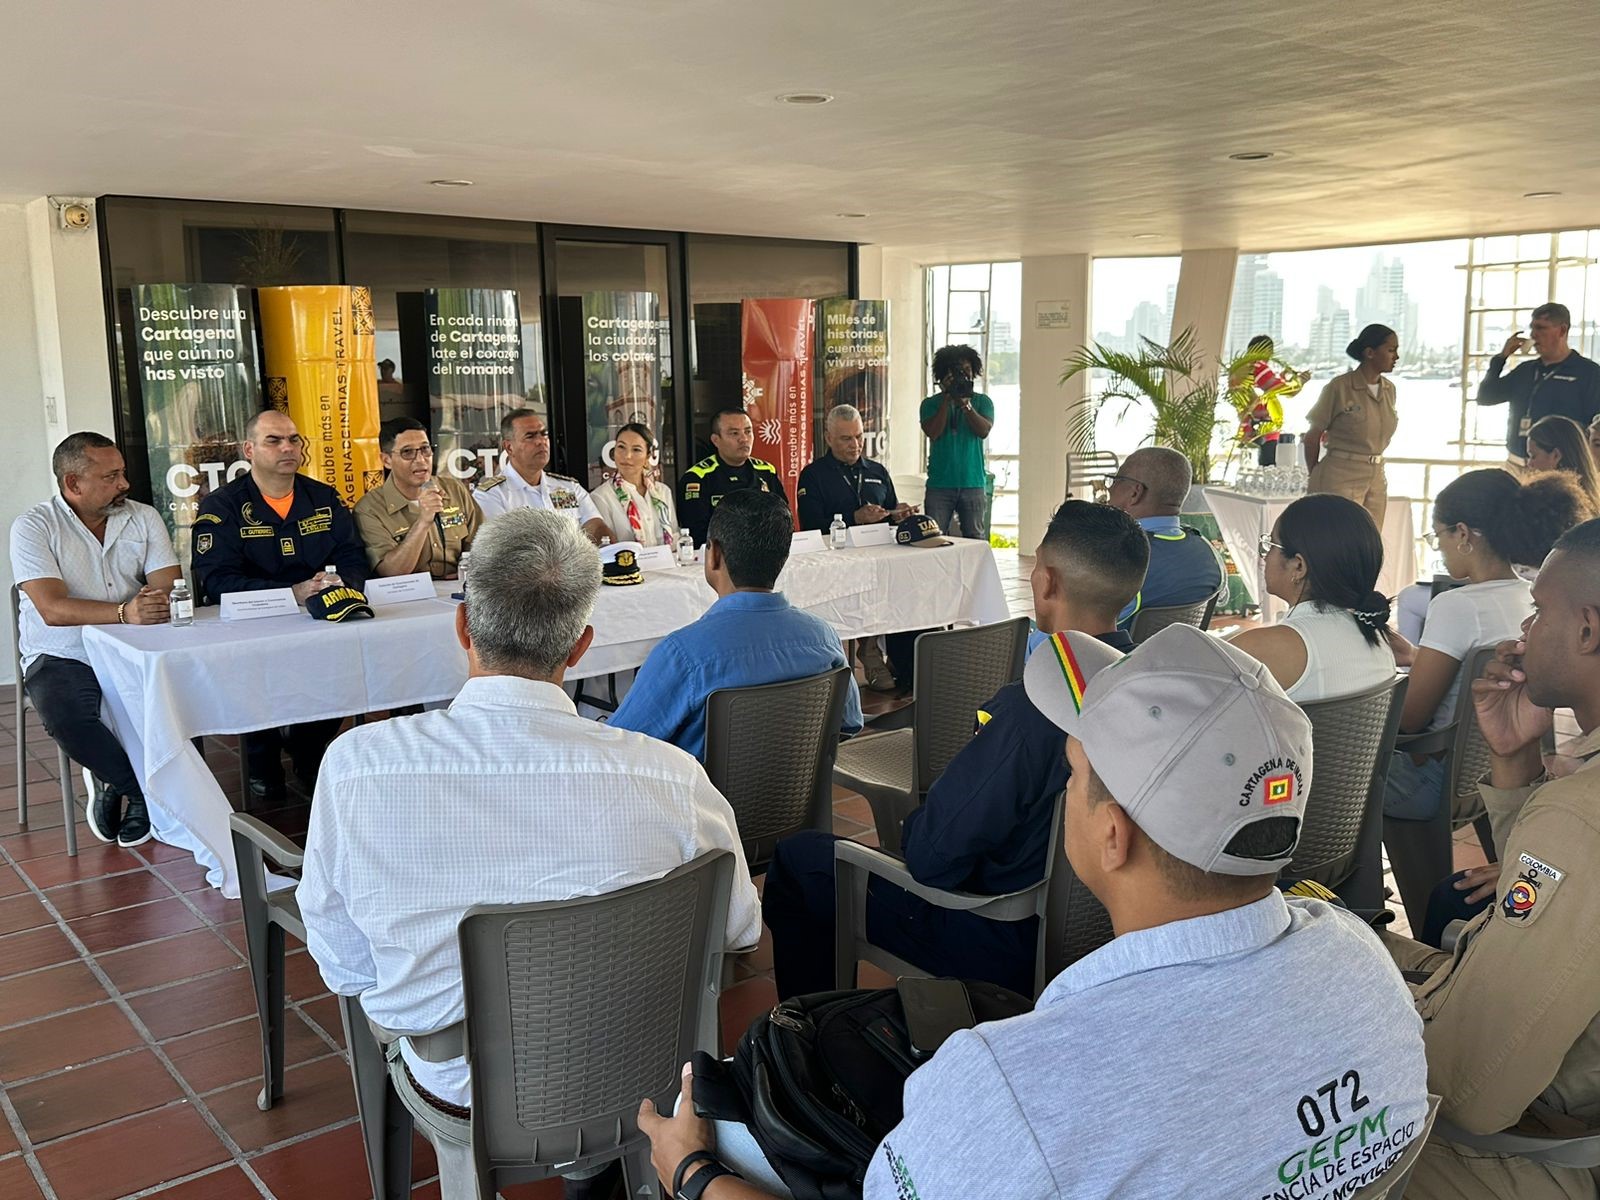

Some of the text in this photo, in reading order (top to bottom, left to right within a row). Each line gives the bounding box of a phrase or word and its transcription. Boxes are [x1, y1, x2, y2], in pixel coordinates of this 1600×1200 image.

[140, 305, 247, 321] Descubre una
[430, 314, 445, 325] En
[448, 313, 484, 326] cada
[827, 313, 876, 325] Miles de
[587, 317, 655, 331] Cartagena
[141, 327, 236, 343] Cartagena
[430, 331, 521, 346] de Cartagena,
[588, 334, 601, 346] la
[604, 333, 647, 346] ciudad
[827, 328, 884, 342] historias y
[143, 345, 235, 362] que aún no
[432, 347, 457, 359] late
[460, 347, 473, 359] el
[589, 350, 609, 362] los
[827, 344, 873, 353] cuentos
[432, 363, 515, 375] del romance
[827, 357, 856, 367] vivir
[857, 359, 866, 370] y
[145, 366, 225, 381] has visto
[320, 395, 331, 411] en
[332, 306, 355, 509] AGENADEINDIAS.TRAVEL
[319, 415, 333, 441] más
[787, 386, 798, 477] Descubre más en
[863, 430, 887, 456] TG
[169, 501, 200, 511] CAR
[1239, 757, 1283, 806] CARTAGENA
[1286, 758, 1295, 771] DE
[1521, 855, 1557, 879] COLOMBIA
[1296, 1069, 1370, 1137] 072
[1277, 1105, 1390, 1184] GEPM
[1261, 1121, 1415, 1200] NCIA DE ESPACIO
